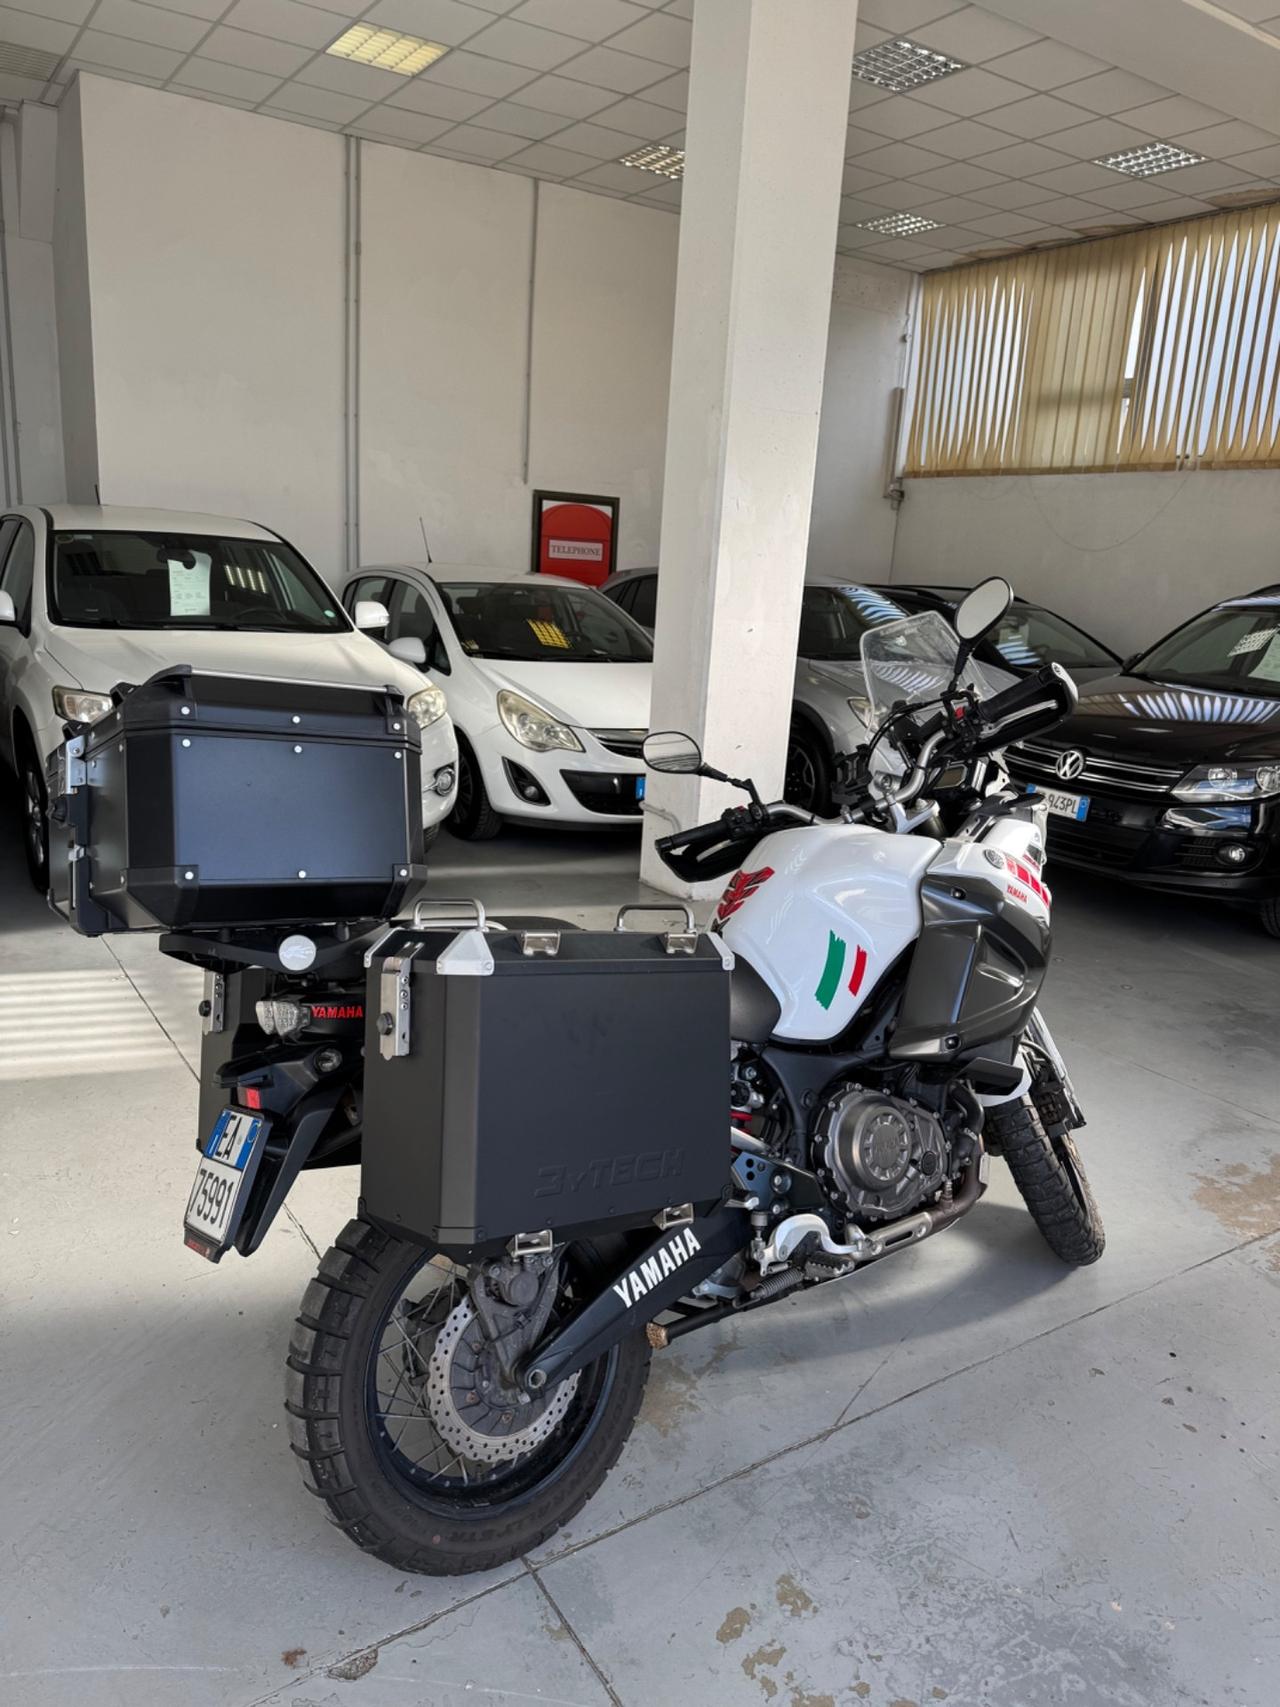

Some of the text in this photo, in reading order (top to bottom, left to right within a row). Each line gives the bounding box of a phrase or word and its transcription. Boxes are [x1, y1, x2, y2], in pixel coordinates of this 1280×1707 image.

[551, 544, 601, 558] TELEPHONE
[1007, 884, 1029, 904] YAMAHA
[311, 1005, 364, 1019] YAMAHA
[214, 1114, 243, 1160] EA
[189, 1169, 234, 1229] 75991
[612, 1227, 702, 1309] YAMAHA
